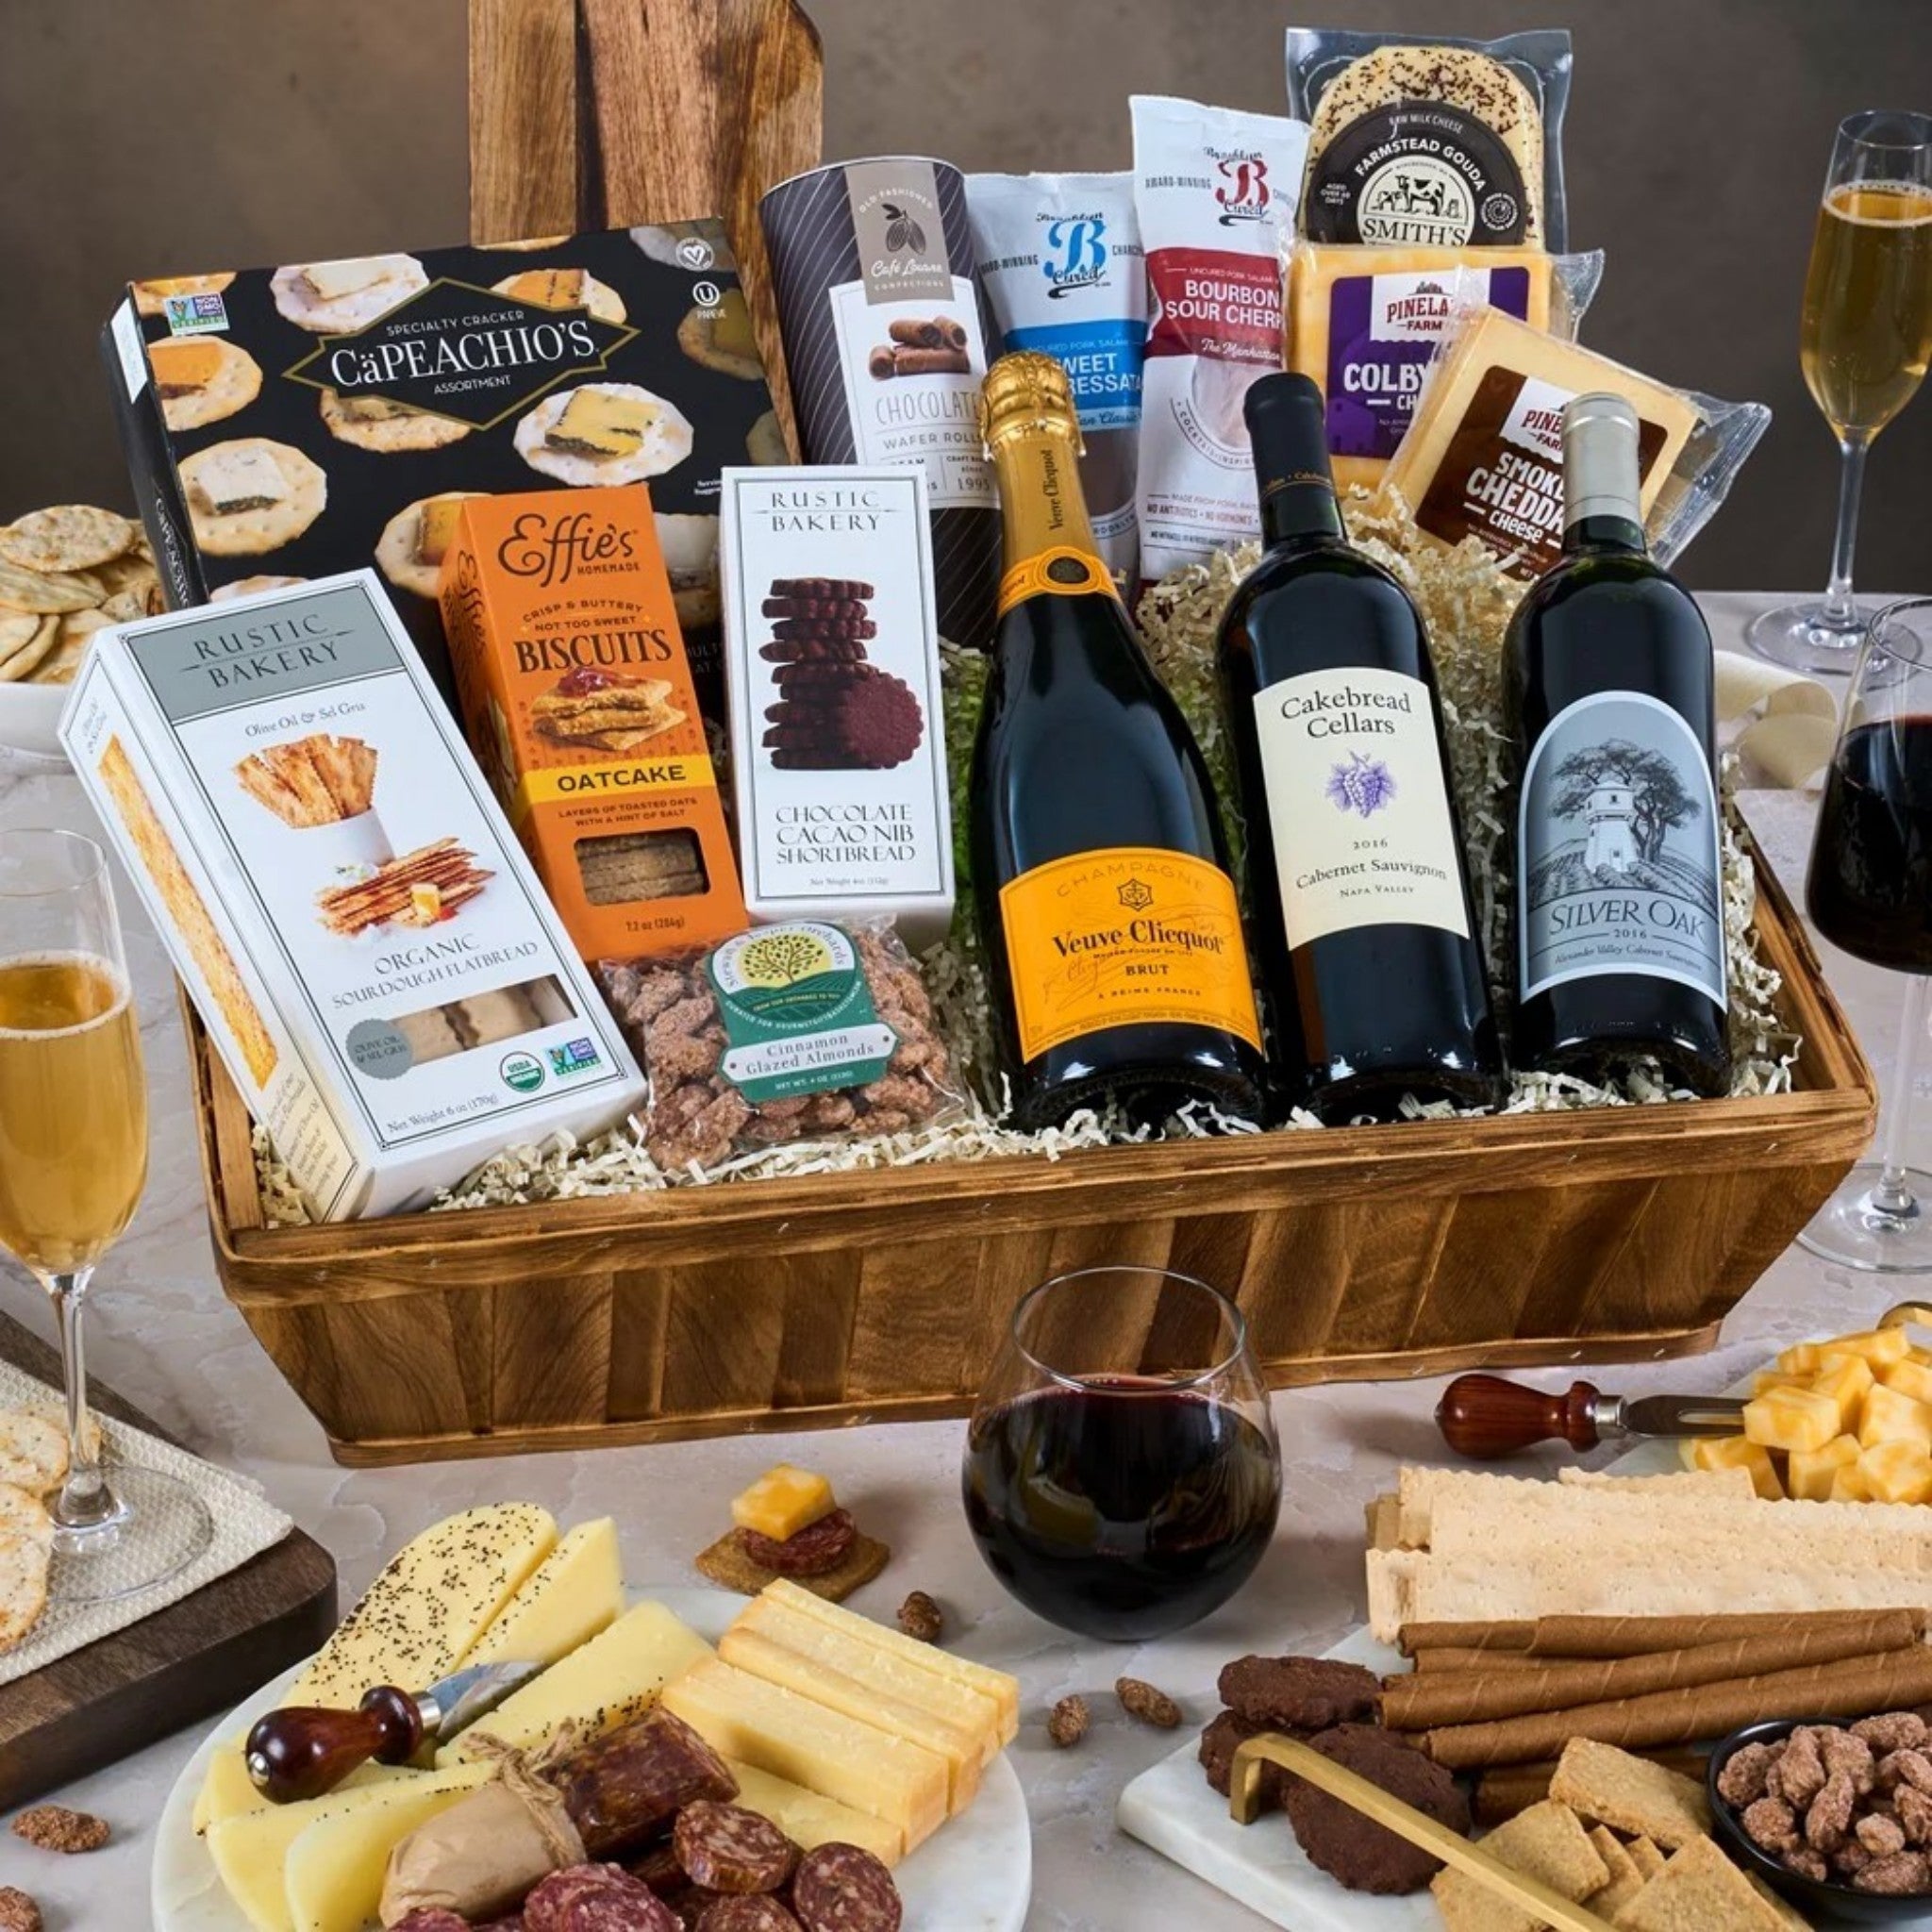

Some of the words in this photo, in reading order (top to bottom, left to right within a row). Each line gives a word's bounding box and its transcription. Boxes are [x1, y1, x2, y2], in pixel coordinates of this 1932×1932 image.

[1432, 115, 1463, 133] CHEESE
[1355, 139, 1440, 176] FARMSTEAD
[1442, 145, 1487, 192] GOUDA
[1145, 176, 1212, 190] AWARD-WINNING
[1215, 159, 1269, 207] B
[859, 195, 877, 213] OLD
[1362, 218, 1466, 245] SMITH'S
[1043, 220, 1106, 277] B
[1190, 267, 1225, 277] UNCURED
[1227, 270, 1245, 279] PORK
[1185, 279, 1279, 308] BOURBON
[1166, 301, 1220, 322] SOUR
[1226, 305, 1283, 328] CHERR
[1387, 296, 1450, 324] PINELA
[386, 317, 458, 337] SPECIALTY
[461, 310, 525, 326] CRACKER
[1201, 338, 1221, 352] The
[1223, 341, 1280, 360] Manhattan
[1058, 353, 1118, 375] WEET
[434, 375, 511, 394] ASSORTMENT
[1521, 409, 1563, 433] PINE
[883, 434, 938, 450] WAFER
[1041, 449, 1058, 497] Clicquot
[772, 491, 879, 508] RUSTIC
[772, 514, 880, 532] BAKERY
[498, 512, 634, 588] Effie's
[577, 562, 641, 575] HOMEMADE
[523, 603, 561, 624] CRISP
[566, 600, 575, 609] &
[580, 599, 644, 613] BUTTERY
[534, 620, 560, 632] NOT
[564, 619, 591, 629] TOO
[592, 615, 637, 626] SWEET
[193, 614, 328, 659] RUSTIC
[514, 628, 673, 674] BISCUITS
[208, 641, 341, 689] BAKERY
[1281, 686, 1412, 720] Cakebread
[244, 722, 277, 737] Olive
[277, 713, 298, 729] Oil
[318, 706, 337, 720] Sel
[1307, 711, 1396, 739] Cellars
[557, 764, 687, 792] OATCAKE
[558, 806, 600, 819] LAYERS
[602, 804, 617, 814] OF
[619, 800, 667, 811] TOASTED
[669, 797, 698, 808] OATS
[575, 815, 604, 826] WITH
[606, 814, 614, 824] A
[616, 811, 641, 823] HINT
[643, 810, 658, 820] OF
[658, 808, 686, 819] SALT
[776, 804, 913, 824] CHOCOLATE
[776, 824, 867, 845] CACAO
[874, 824, 914, 842] NIB
[1353, 839, 1389, 850] 2016
[776, 845, 916, 864] SHORTBREAD
[1057, 862, 1203, 897] CHAMPAGNE
[1296, 859, 1366, 890] Cabernet
[1371, 858, 1447, 881] Sauvignon
[1340, 886, 1371, 898] NAPA
[1375, 884, 1414, 894] VALLEY
[1550, 899, 1644, 936] SILVER
[1648, 899, 1706, 942] OAK
[1053, 928, 1124, 958] Veuve
[1129, 919, 1224, 955] Clicquot
[1613, 928, 1647, 939] 2016
[374, 933, 481, 975] ORGANIC
[1597, 944, 1623, 956] Valley
[1626, 944, 1663, 957] Cabernet
[332, 966, 445, 1008] SOURDOUGH
[445, 941, 540, 980] FLATBREAD
[1125, 964, 1170, 975] BRUT
[1157, 987, 1201, 996] FRANCE
[725, 1000, 756, 1024] CURATED
[757, 1019, 773, 1027] FOR
[766, 1035, 848, 1057] Cinnamon
[745, 1055, 800, 1075] Glazed
[805, 1043, 874, 1065] Almonds
[775, 1081, 791, 1091] NET
[817, 1075, 827, 1084] OZ
[387, 1121, 408, 1133] Net
[408, 1109, 445, 1125] Weight
